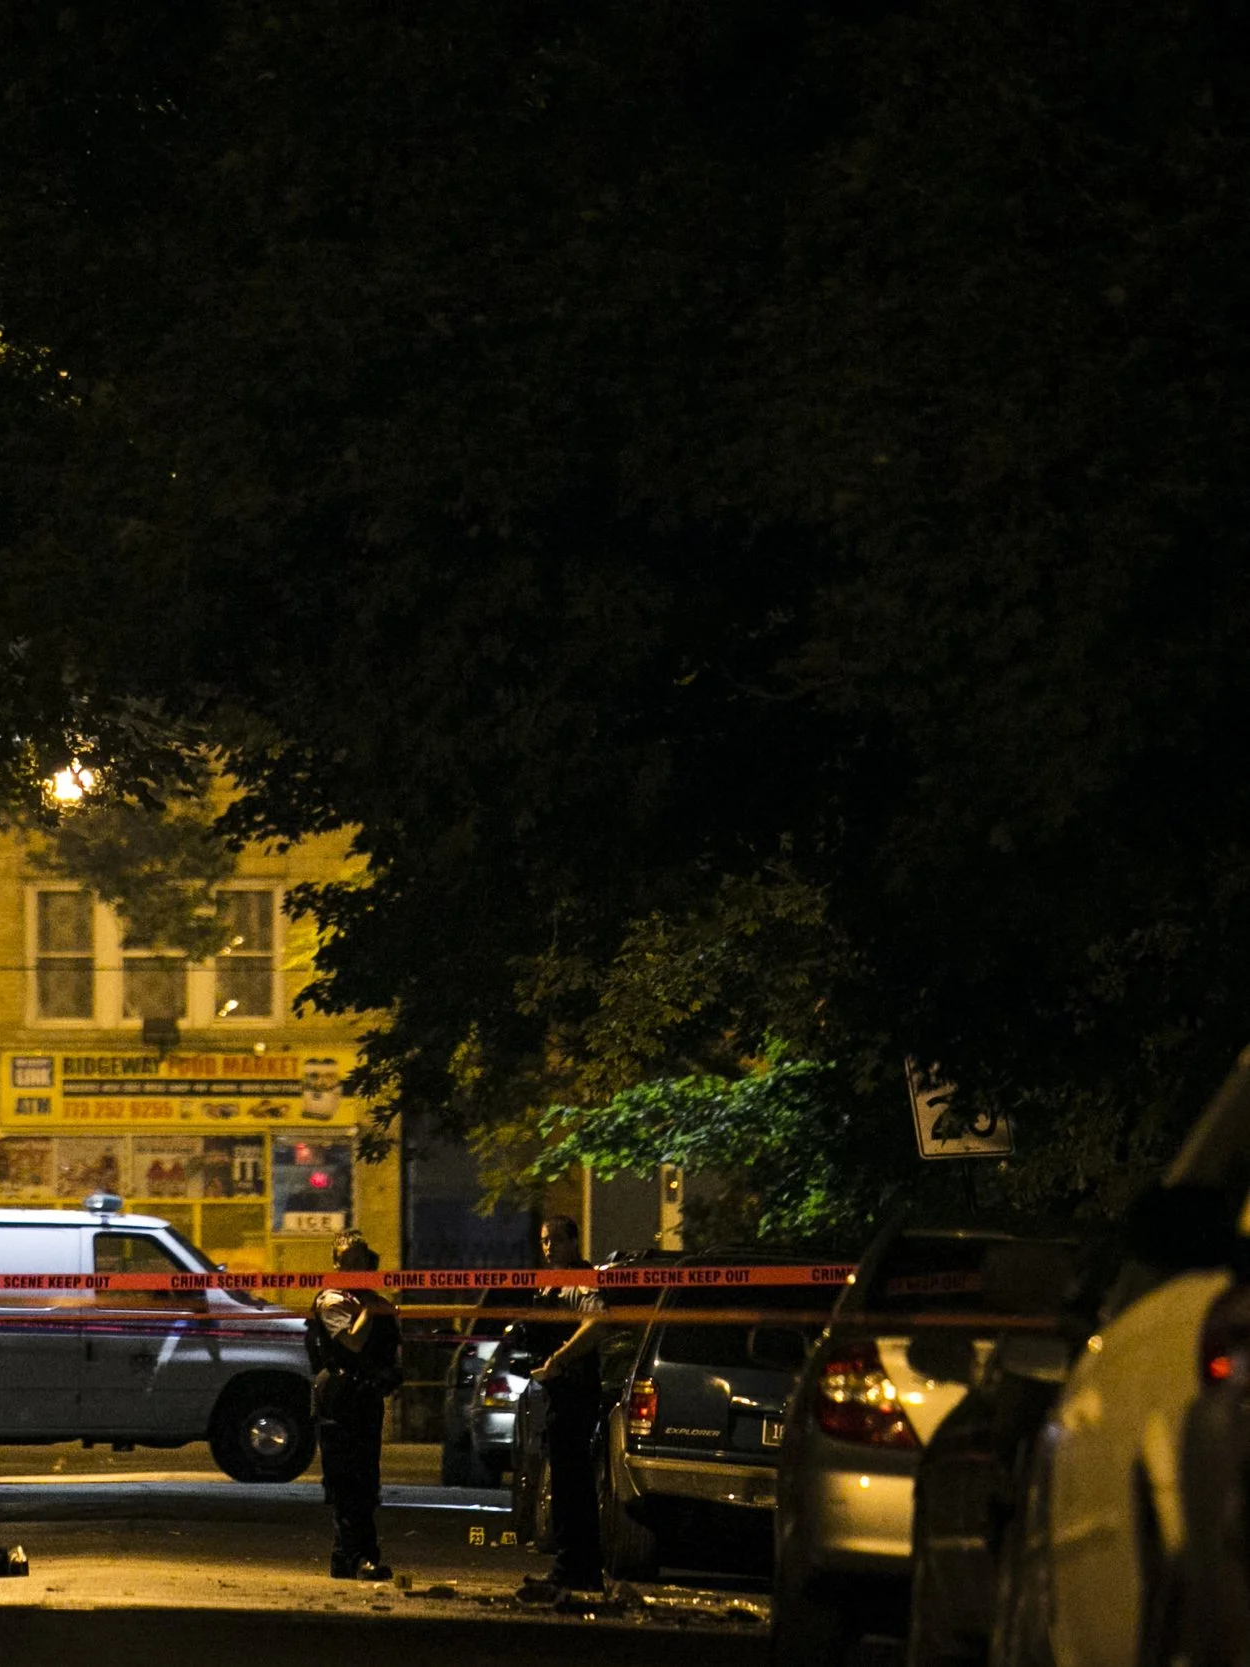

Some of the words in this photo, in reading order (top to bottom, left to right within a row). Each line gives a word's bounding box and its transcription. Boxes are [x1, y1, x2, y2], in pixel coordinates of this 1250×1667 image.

[63, 1056, 160, 1073] RIDGEWAY
[223, 1055, 298, 1073] MARKET
[16, 1097, 49, 1114] ATM
[297, 1216, 332, 1227] ICE
[4, 1276, 43, 1288] SCENE
[48, 1276, 81, 1288] KEEP
[86, 1276, 110, 1288] OUT
[171, 1275, 212, 1287] CRIME
[217, 1275, 257, 1287] SCENE
[262, 1275, 294, 1287] KEEP
[299, 1275, 324, 1287] OUT
[384, 1273, 424, 1286] CRIME
[430, 1273, 469, 1286] SCENE
[475, 1273, 507, 1286] KEEP
[512, 1273, 536, 1286] OUT
[597, 1271, 638, 1283] CRIME
[644, 1271, 683, 1283] SCENE
[688, 1271, 720, 1283] KEEP
[726, 1271, 750, 1283] OUT
[665, 1427, 721, 1437] EXPLORER
[472, 1534, 482, 1544] 23
